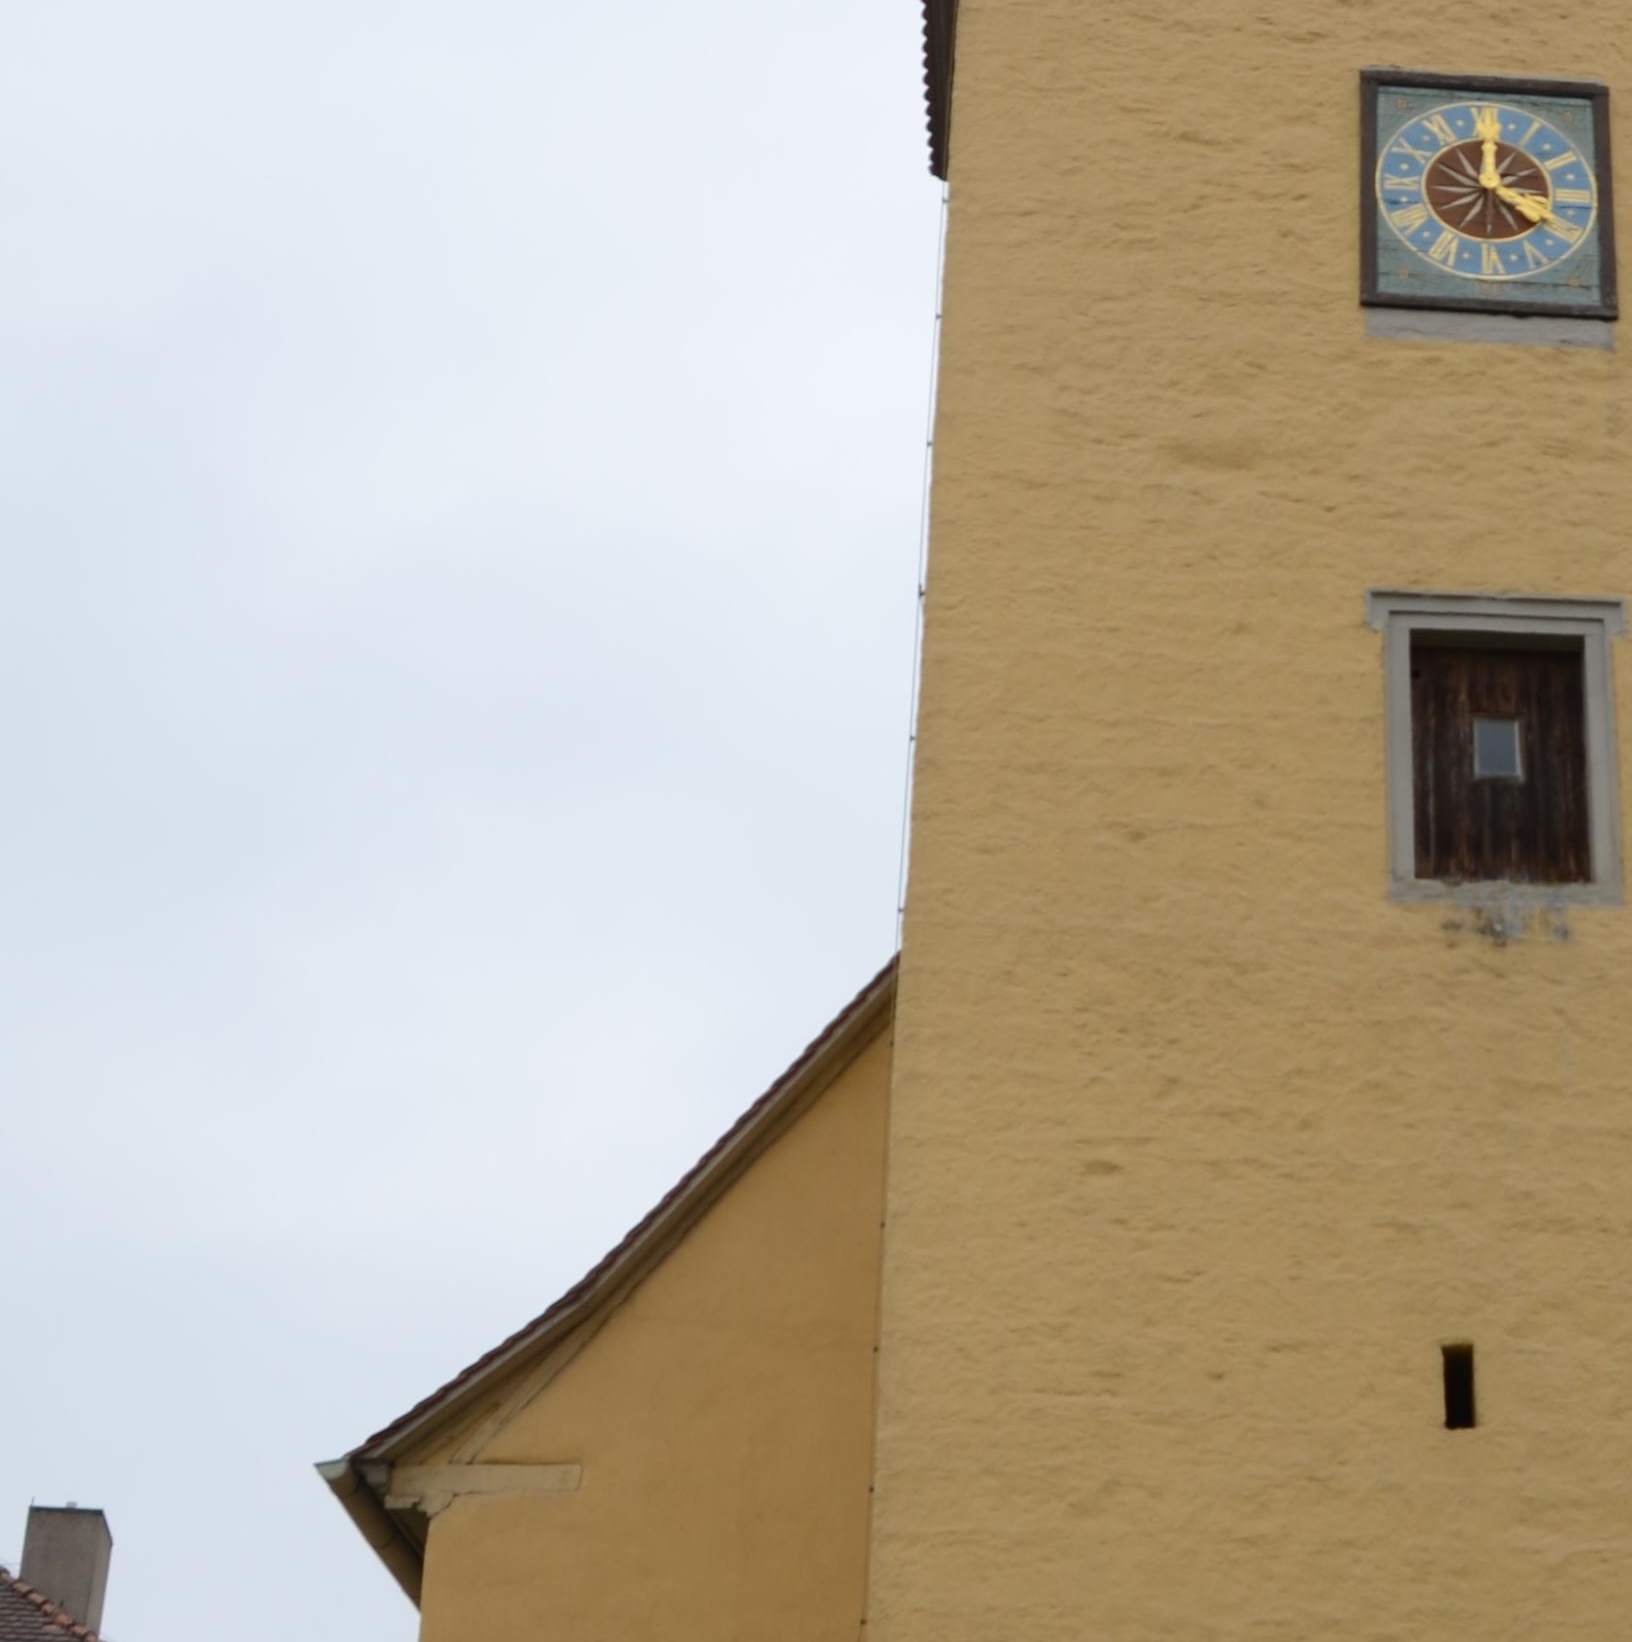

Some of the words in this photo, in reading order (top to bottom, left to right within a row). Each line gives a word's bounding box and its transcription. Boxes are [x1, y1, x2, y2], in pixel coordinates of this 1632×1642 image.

[1421, 113, 1457, 146] XI
[1391, 138, 1433, 164] X
[1543, 151, 1576, 170] II
[1383, 173, 1419, 189] IX
[1555, 188, 1590, 203] III
[1523, 239, 1550, 269] V
